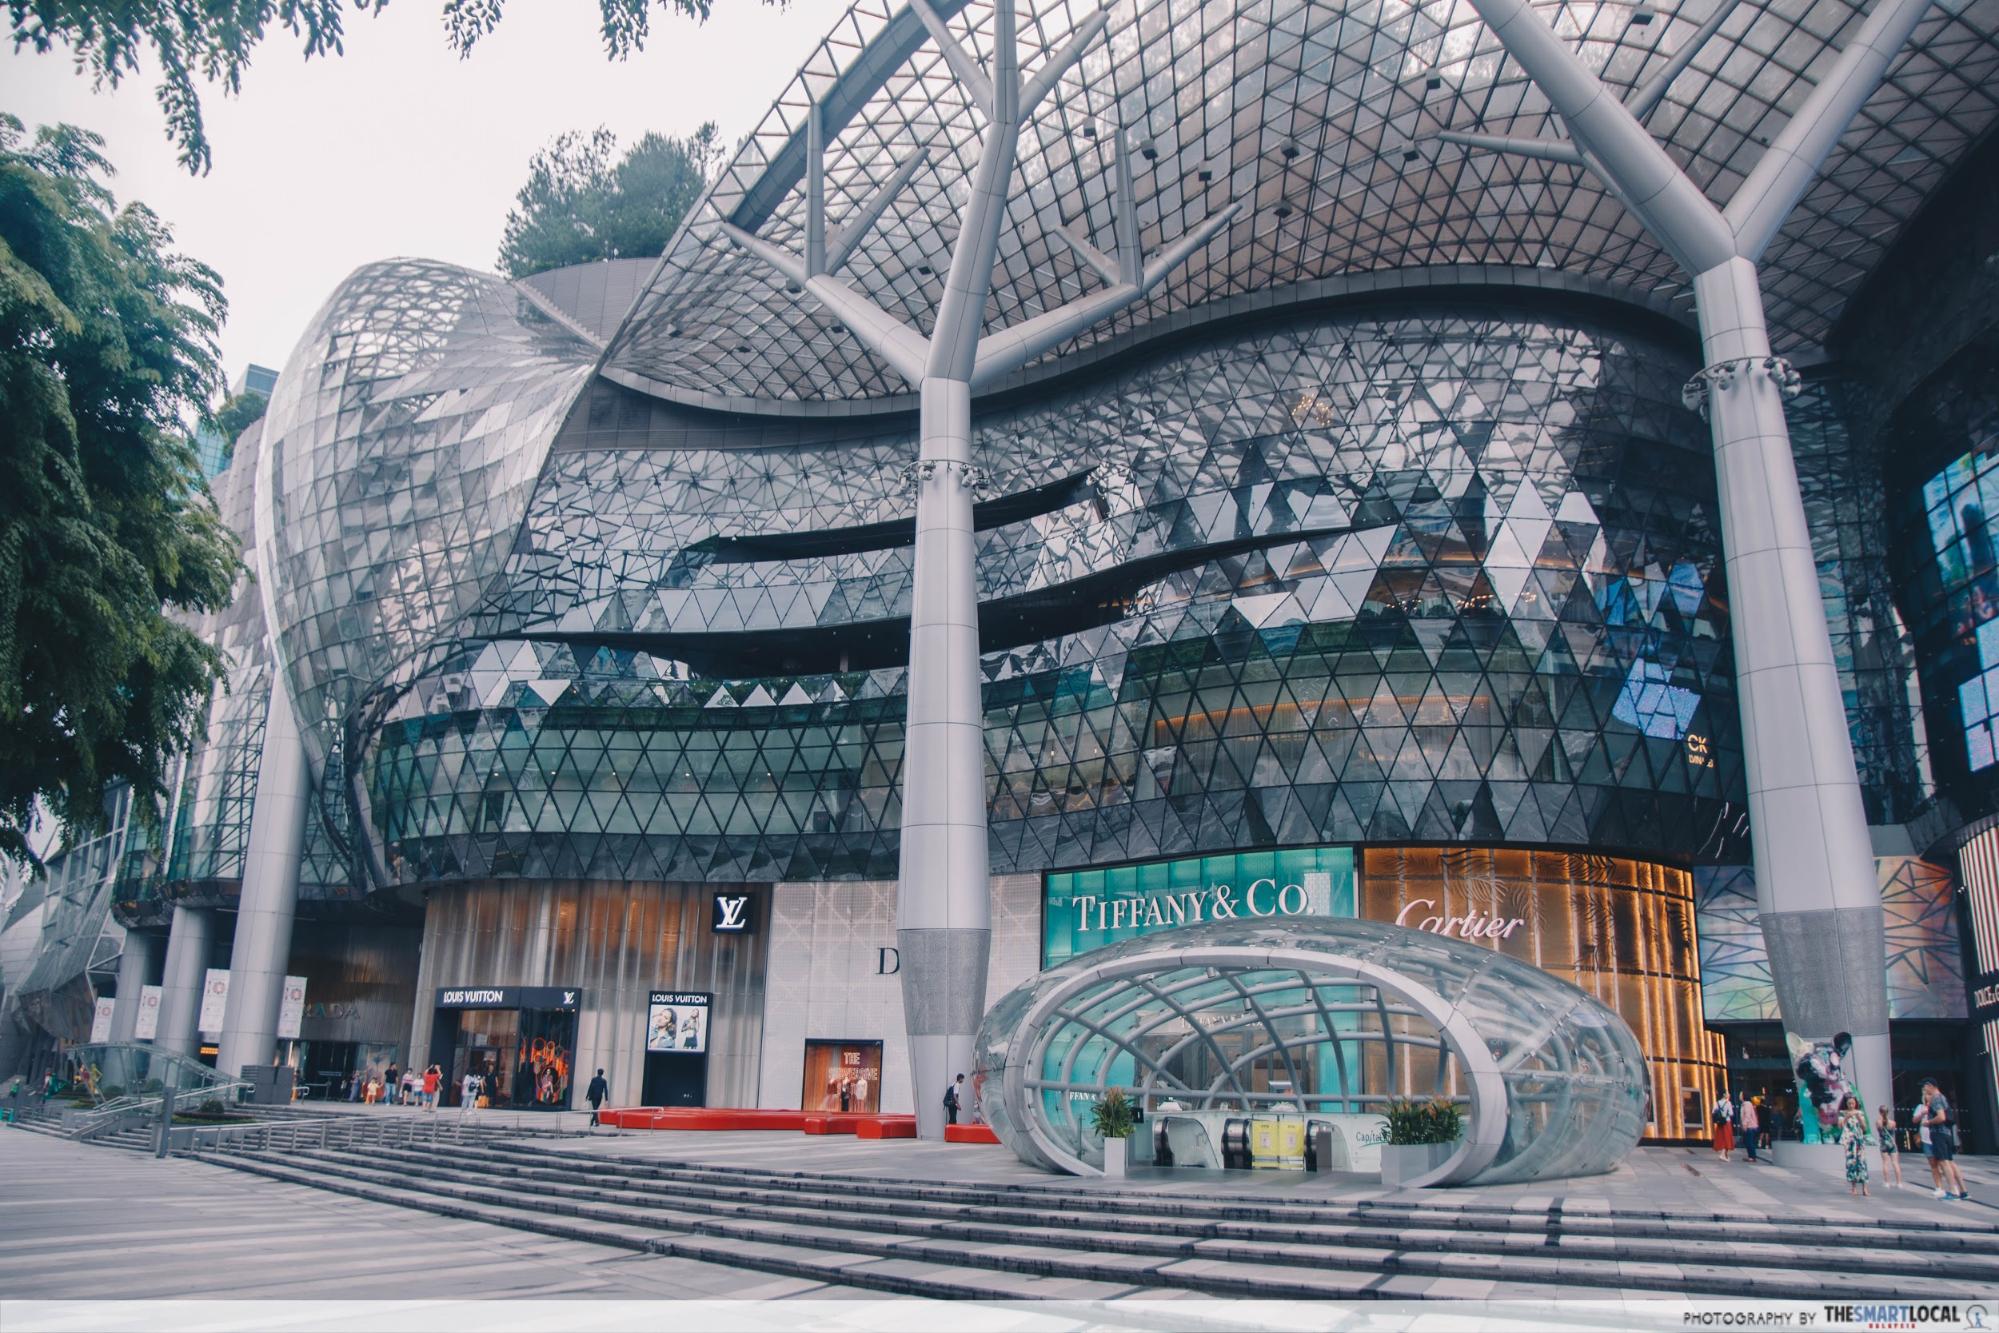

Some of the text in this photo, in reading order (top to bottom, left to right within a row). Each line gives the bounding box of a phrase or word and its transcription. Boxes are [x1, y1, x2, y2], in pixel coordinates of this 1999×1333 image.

[1072, 891, 1209, 931] TIFFANY
[1211, 884, 1240, 919] &
[1395, 898, 1525, 939] Cartier
[443, 990, 504, 1003] LOUIS VUITTON
[651, 993, 708, 1004] LOUIS VUITTON
